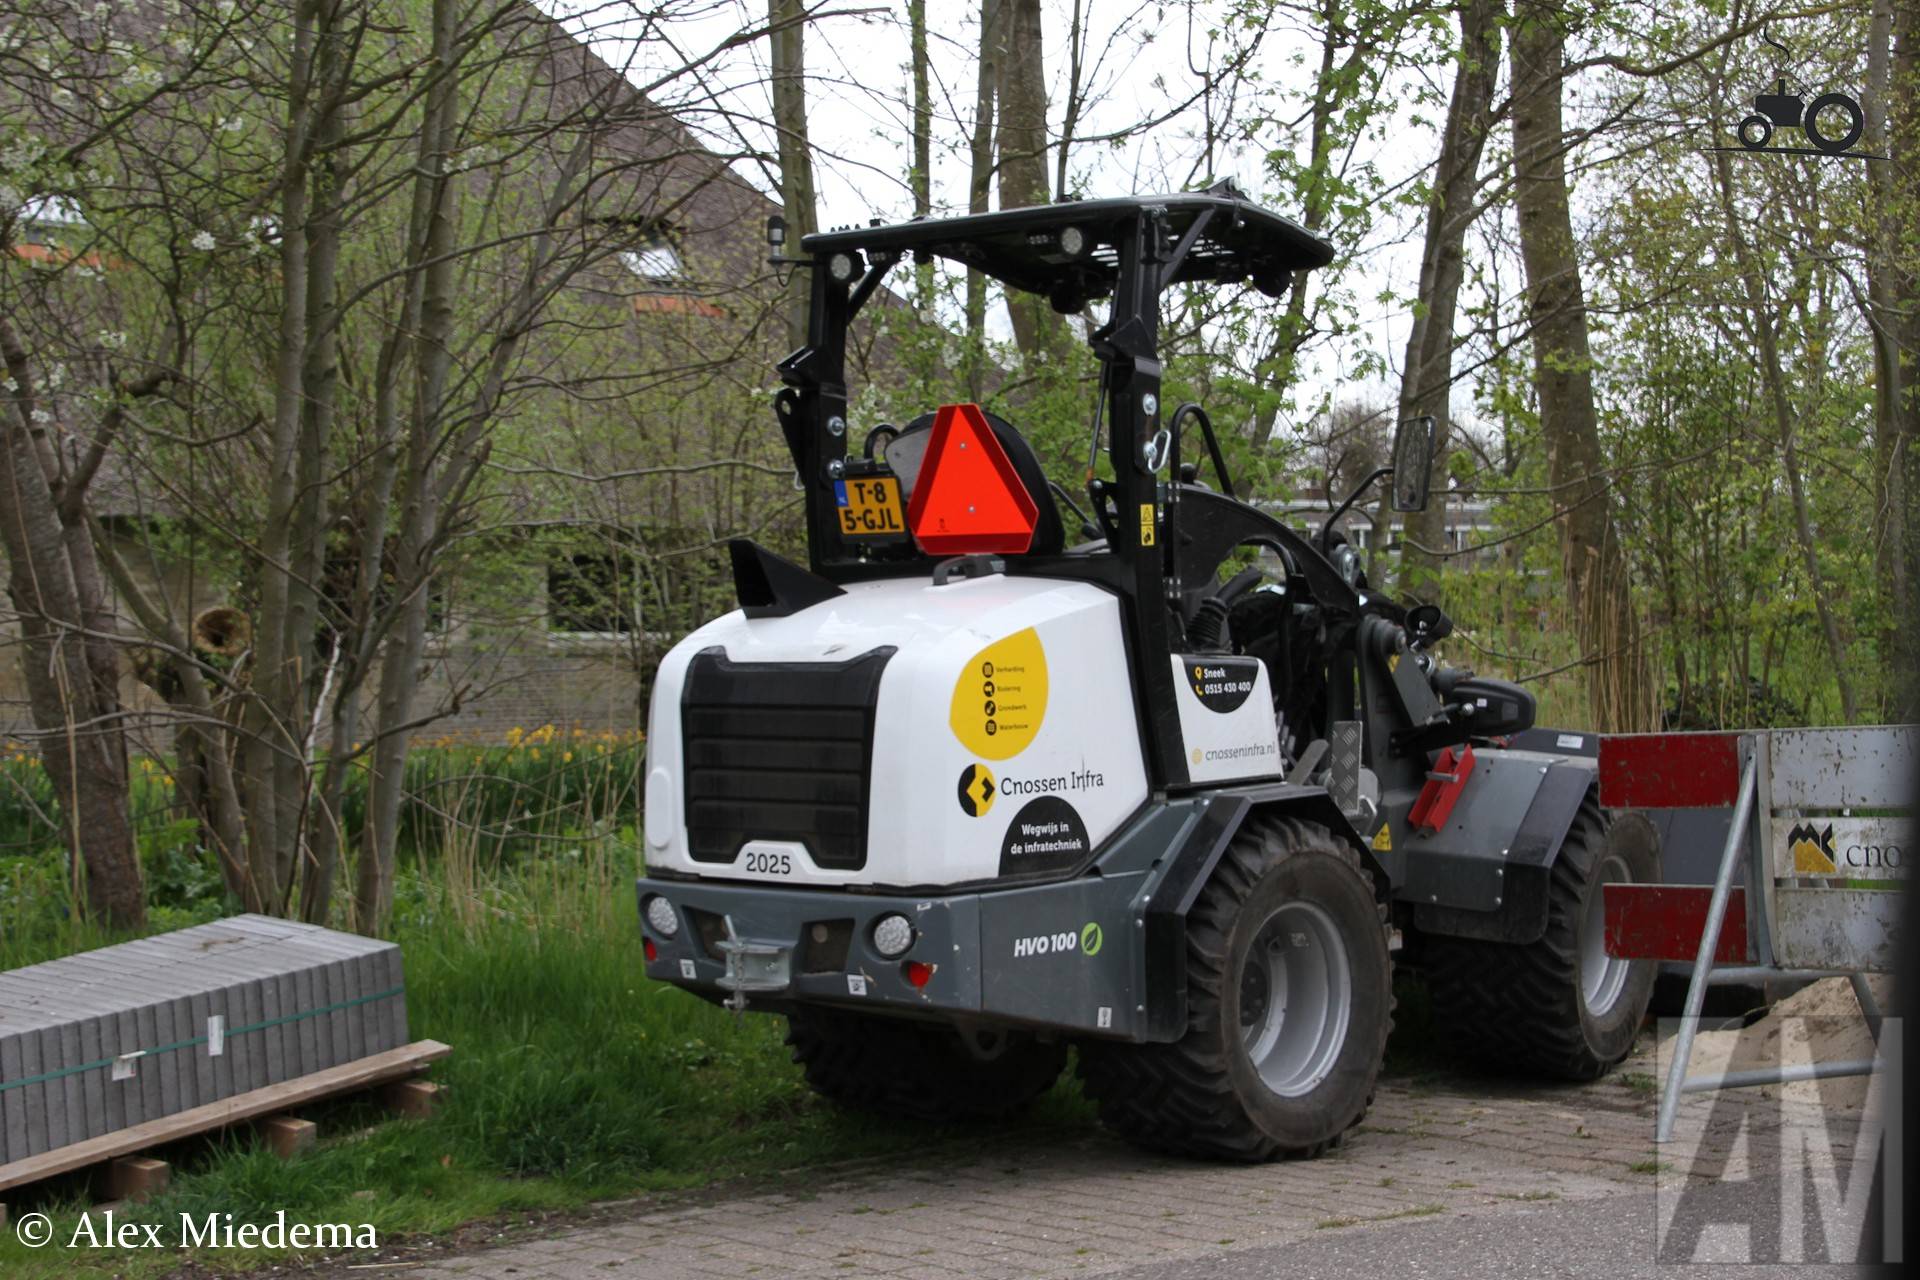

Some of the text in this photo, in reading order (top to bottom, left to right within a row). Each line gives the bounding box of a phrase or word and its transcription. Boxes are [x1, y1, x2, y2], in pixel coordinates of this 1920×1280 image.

[854, 482, 887, 505] T-8
[844, 508, 900, 530] 5-GJL
[1203, 667, 1226, 679] Sneek
[1205, 681, 1251, 695] 0515 430 400
[1205, 741, 1276, 761] cnosseninfra.nl
[1001, 770, 1104, 796] Cnossen Infra
[1021, 821, 1070, 837] Wegwijs in
[1010, 838, 1082, 855] de infratechniek
[746, 852, 791, 875] 2025
[1014, 932, 1077, 958] HVO 100
